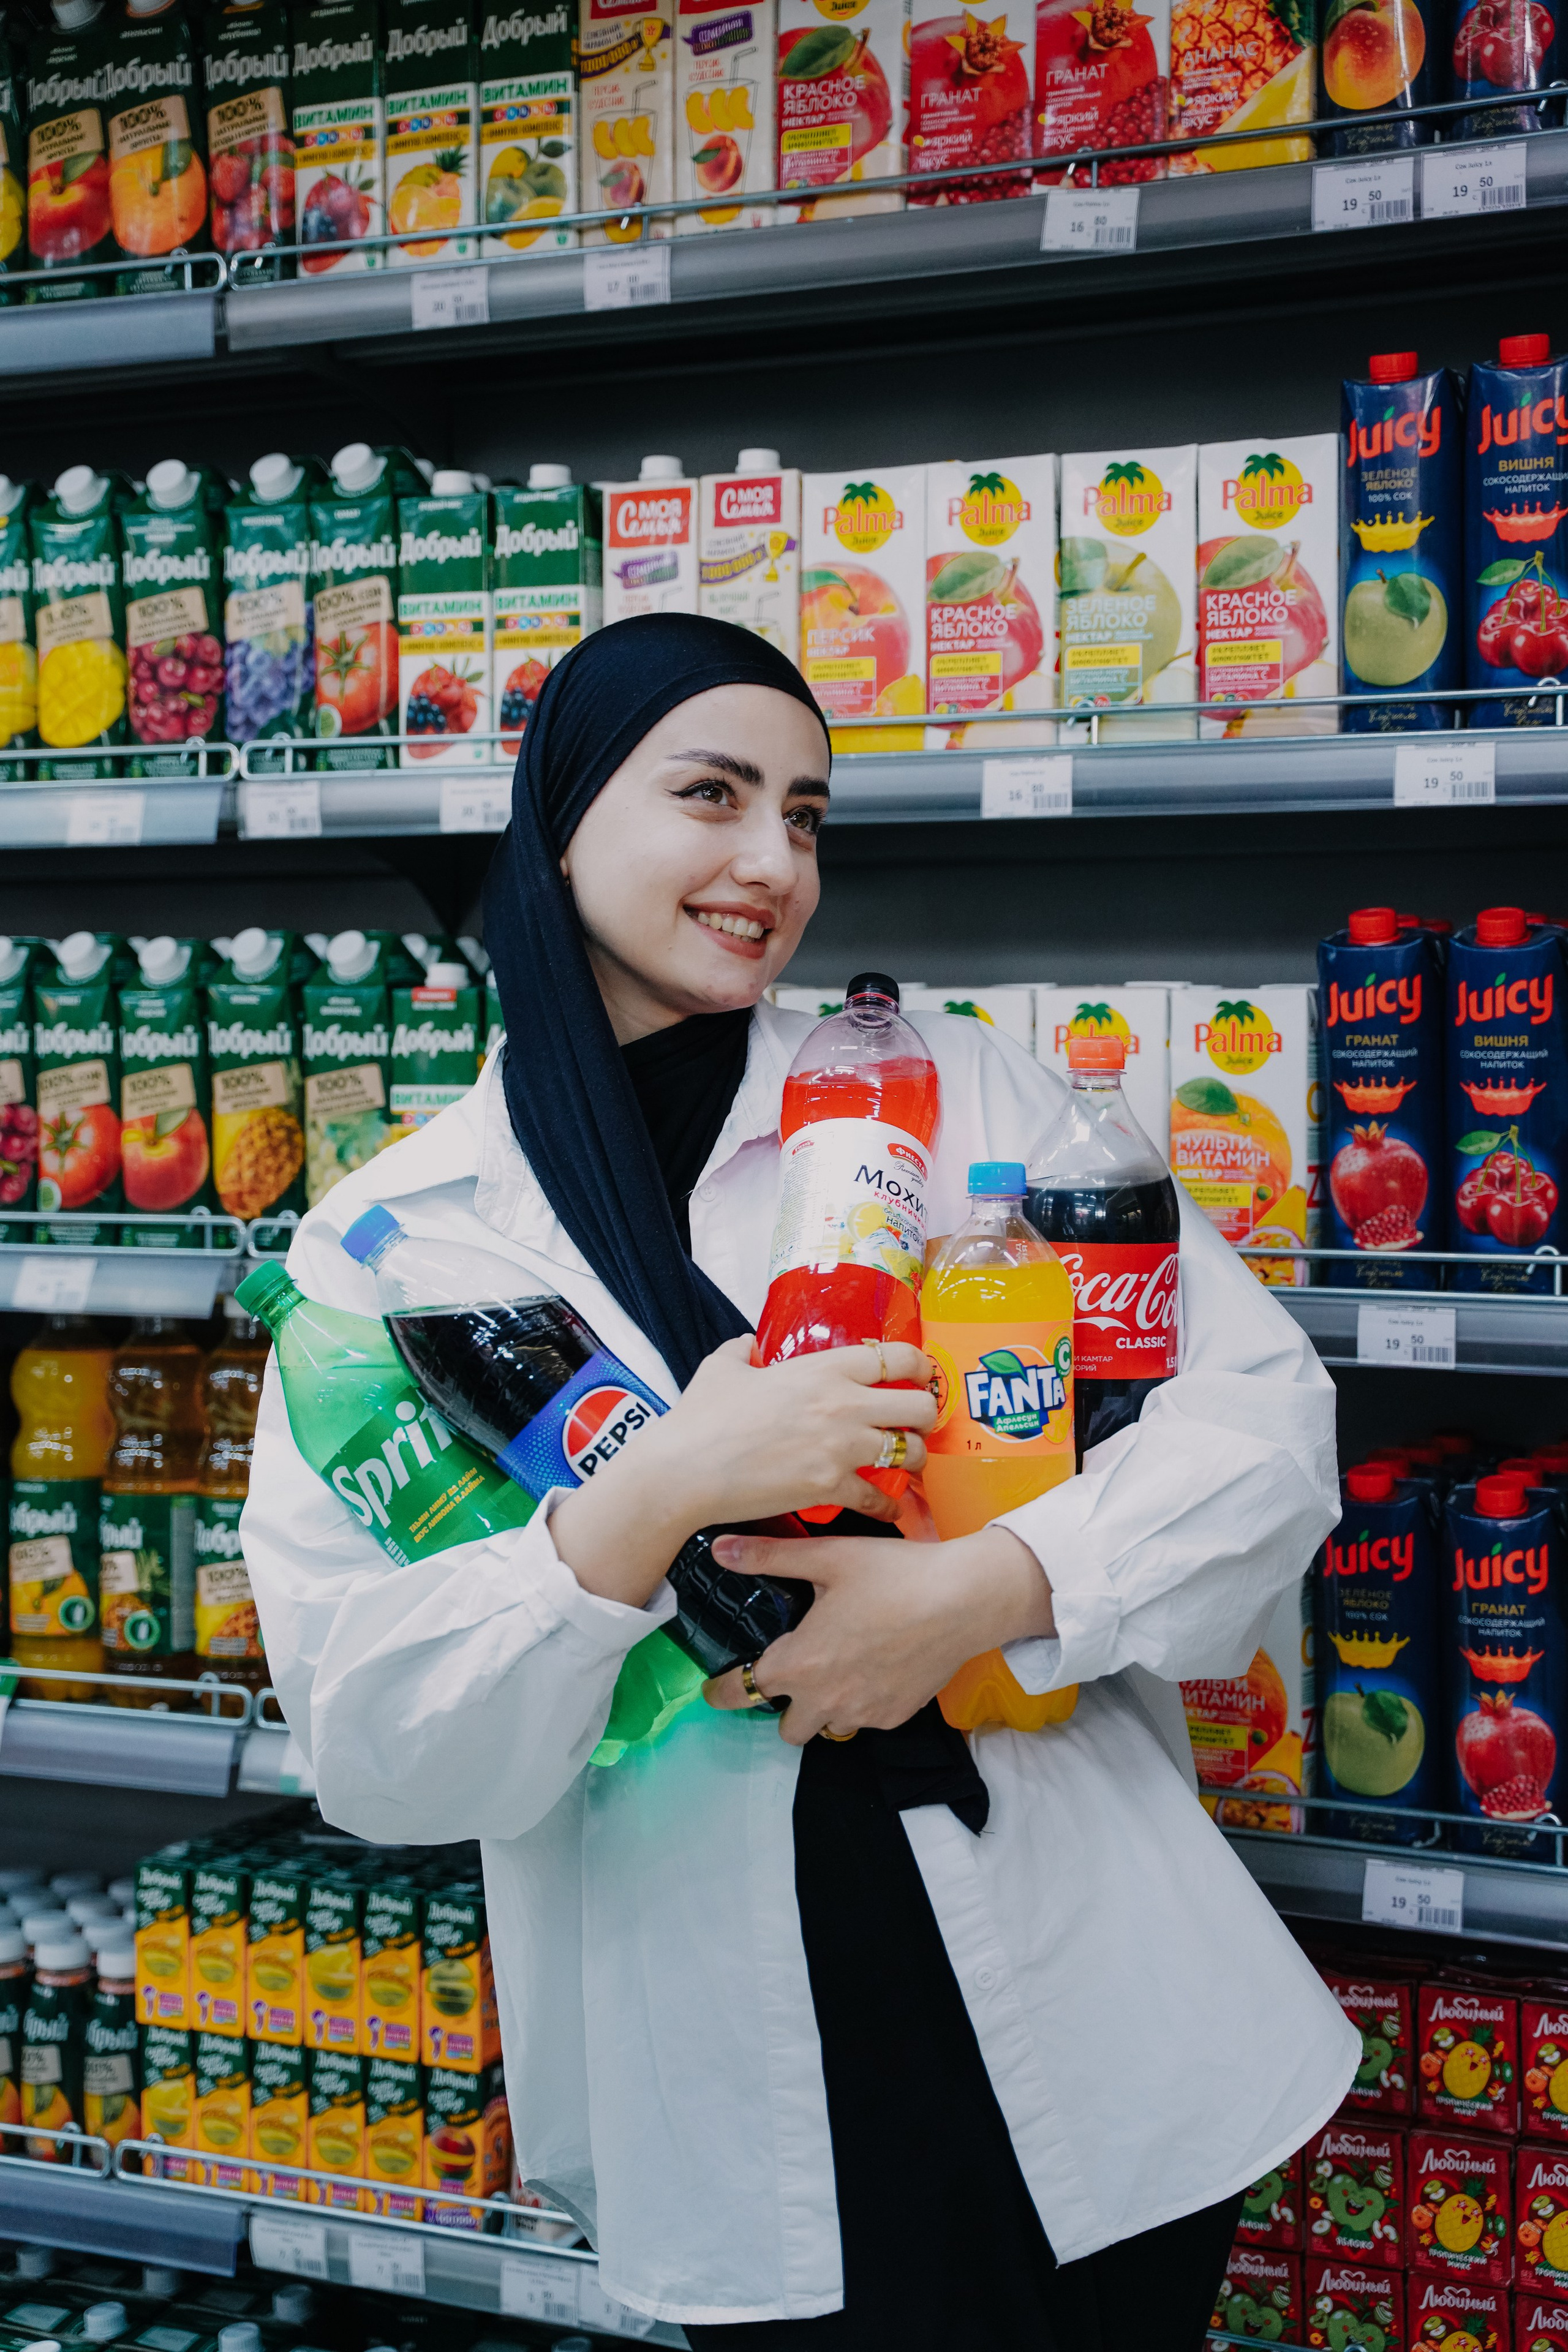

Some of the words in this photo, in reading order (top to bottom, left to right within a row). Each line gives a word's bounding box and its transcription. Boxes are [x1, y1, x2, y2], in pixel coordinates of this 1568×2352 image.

[481, 4, 568, 50] Добрый
[386, 17, 468, 63] Добрый
[292, 32, 374, 77] Добрый
[1183, 42, 1259, 66] АНАНАС
[1046, 63, 1109, 86] ГРАНАТ
[483, 77, 567, 103] ВИТАМИН
[783, 74, 865, 100] КРАСНОЕ
[1194, 86, 1238, 108] яркий
[388, 90, 467, 115] ВИТАМИН
[783, 92, 858, 116] ЯБЛОКО
[921, 87, 982, 109] ГРАНАТ
[118, 104, 167, 132] 100%
[216, 97, 263, 123] 100%
[1061, 106, 1099, 127] яркий
[782, 113, 826, 128] НЕКТАР
[1182, 115, 1214, 130] вкус
[1043, 132, 1076, 149] вкус
[1453, 185, 1468, 198] 19
[1479, 176, 1493, 187] 50
[1343, 198, 1357, 211] 19
[1368, 190, 1382, 202] 50
[1477, 392, 1568, 455] Juicy
[1348, 405, 1442, 469] Juicy
[1498, 456, 1555, 472] ВИШНЯ
[1365, 479, 1414, 491] ЯБЛОКО
[1483, 472, 1568, 487] СОКОСОДЕРЖАЩИ
[1504, 483, 1551, 494] НАПИТОК
[1083, 483, 1172, 516] Palma
[1222, 475, 1314, 511] Palma
[1368, 493, 1392, 503] 100%
[1392, 492, 1413, 501] СОК
[823, 503, 905, 536] Palma
[948, 494, 1032, 527] Palma
[1254, 510, 1284, 521] Juice
[399, 527, 483, 567] Добрый
[494, 519, 579, 560] Добрый
[401, 600, 481, 615] ВИТАМИН
[496, 592, 579, 611] ВИТАМИН
[1066, 594, 1157, 613] ЗЕЛЕНОЕ
[1206, 589, 1297, 611] КРАСНОЕ
[930, 604, 1017, 622] КРАСНОЕ
[1066, 612, 1148, 632] ЯБЛОКО
[1206, 605, 1289, 627] ЯБЛОКО
[807, 626, 876, 646] ПЕРСИК
[930, 620, 1009, 639] ЯБЛОКО
[1065, 631, 1113, 644] НЕКТАР
[1205, 626, 1253, 639] НЕКТАР
[930, 641, 975, 652] НЕКТАР
[1423, 777, 1438, 789] 19
[1450, 771, 1463, 781] 50
[1326, 972, 1422, 1028] Juicy
[1455, 972, 1554, 1027] Juicy
[391, 1021, 475, 1059] Добрый
[1194, 1020, 1283, 1055] Palma
[1345, 1033, 1400, 1047] ГРАНАТ
[1474, 1035, 1529, 1048] ВИШНЯ
[1332, 1047, 1419, 1060] СОКОСОДЕРЖАЩИЙ
[1351, 1059, 1395, 1068] НАПИТОК
[1460, 1048, 1549, 1060] СОКОСОДЕРЖАЩИЙ
[1480, 1060, 1525, 1069] НАПИТОК
[1176, 1134, 1253, 1151] МУЛЬТИ
[895, 1147, 927, 1174] ФИЕСТА
[1175, 1150, 1270, 1167] ВИТАМИН
[894, 1161, 921, 1180] Premium
[1176, 1169, 1223, 1180] НЕКТАР
[911, 1176, 924, 1188] quality
[853, 1164, 929, 1224] МОХИТ
[873, 1191, 927, 1232] клубничны
[1115, 1336, 1167, 1349] CLASSIC
[1385, 1338, 1400, 1351] 19
[1411, 1334, 1424, 1344] 50
[1058, 1343, 1071, 1370] C
[966, 1366, 1066, 1419] FANTA
[996, 1413, 1038, 1425] Афлесун
[996, 1420, 1040, 1433] Апельсин
[577, 1401, 652, 1477] PEPSI
[967, 1439, 971, 1450] 1
[331, 1400, 454, 1530] Sprit
[409, 1511, 430, 1533] ТАЪМИ
[447, 1484, 459, 1496] ВА
[458, 1467, 478, 1488] ЛАЙМ
[413, 1526, 429, 1544] ВКУС
[428, 1501, 456, 1529] ЛИМОНА
[454, 1494, 462, 1504] И
[460, 1475, 485, 1499] ЛАЙМА
[1323, 1529, 1414, 1581] Juicy
[1452, 1542, 1549, 1595] Juicy
[1343, 1599, 1390, 1610] ЯБЛОКО
[1471, 1602, 1527, 1616] ГРАНАТ
[1369, 1611, 1389, 1621] СОК
[1458, 1615, 1546, 1629] СОКОСОДЕРЖАЩИЙ
[1478, 1627, 1523, 1638] НАПИТОК
[1182, 1679, 1248, 1693] УЛЬТИ
[1392, 1896, 1407, 1909] 19
[1417, 1893, 1431, 1905] 50
[1428, 1996, 1505, 2022] Любимый
[1436, 2095, 1494, 2111] ТРОПИЧЕСКИЙ
[1453, 2107, 1478, 2117] МИКС
[1316, 2133, 1391, 2159] Любимый
[1419, 2148, 1496, 2174] Любимый
[1336, 2236, 1374, 2251] ЯБЛОКО
[1226, 2253, 1289, 2278] юбимый
[1428, 2248, 1488, 2266] ТРОПИЧЕСКИЙ
[1447, 2260, 1472, 2271] МИКС
[1316, 2269, 1392, 2295] Любимый
[1419, 2284, 1497, 2312] Любимый
